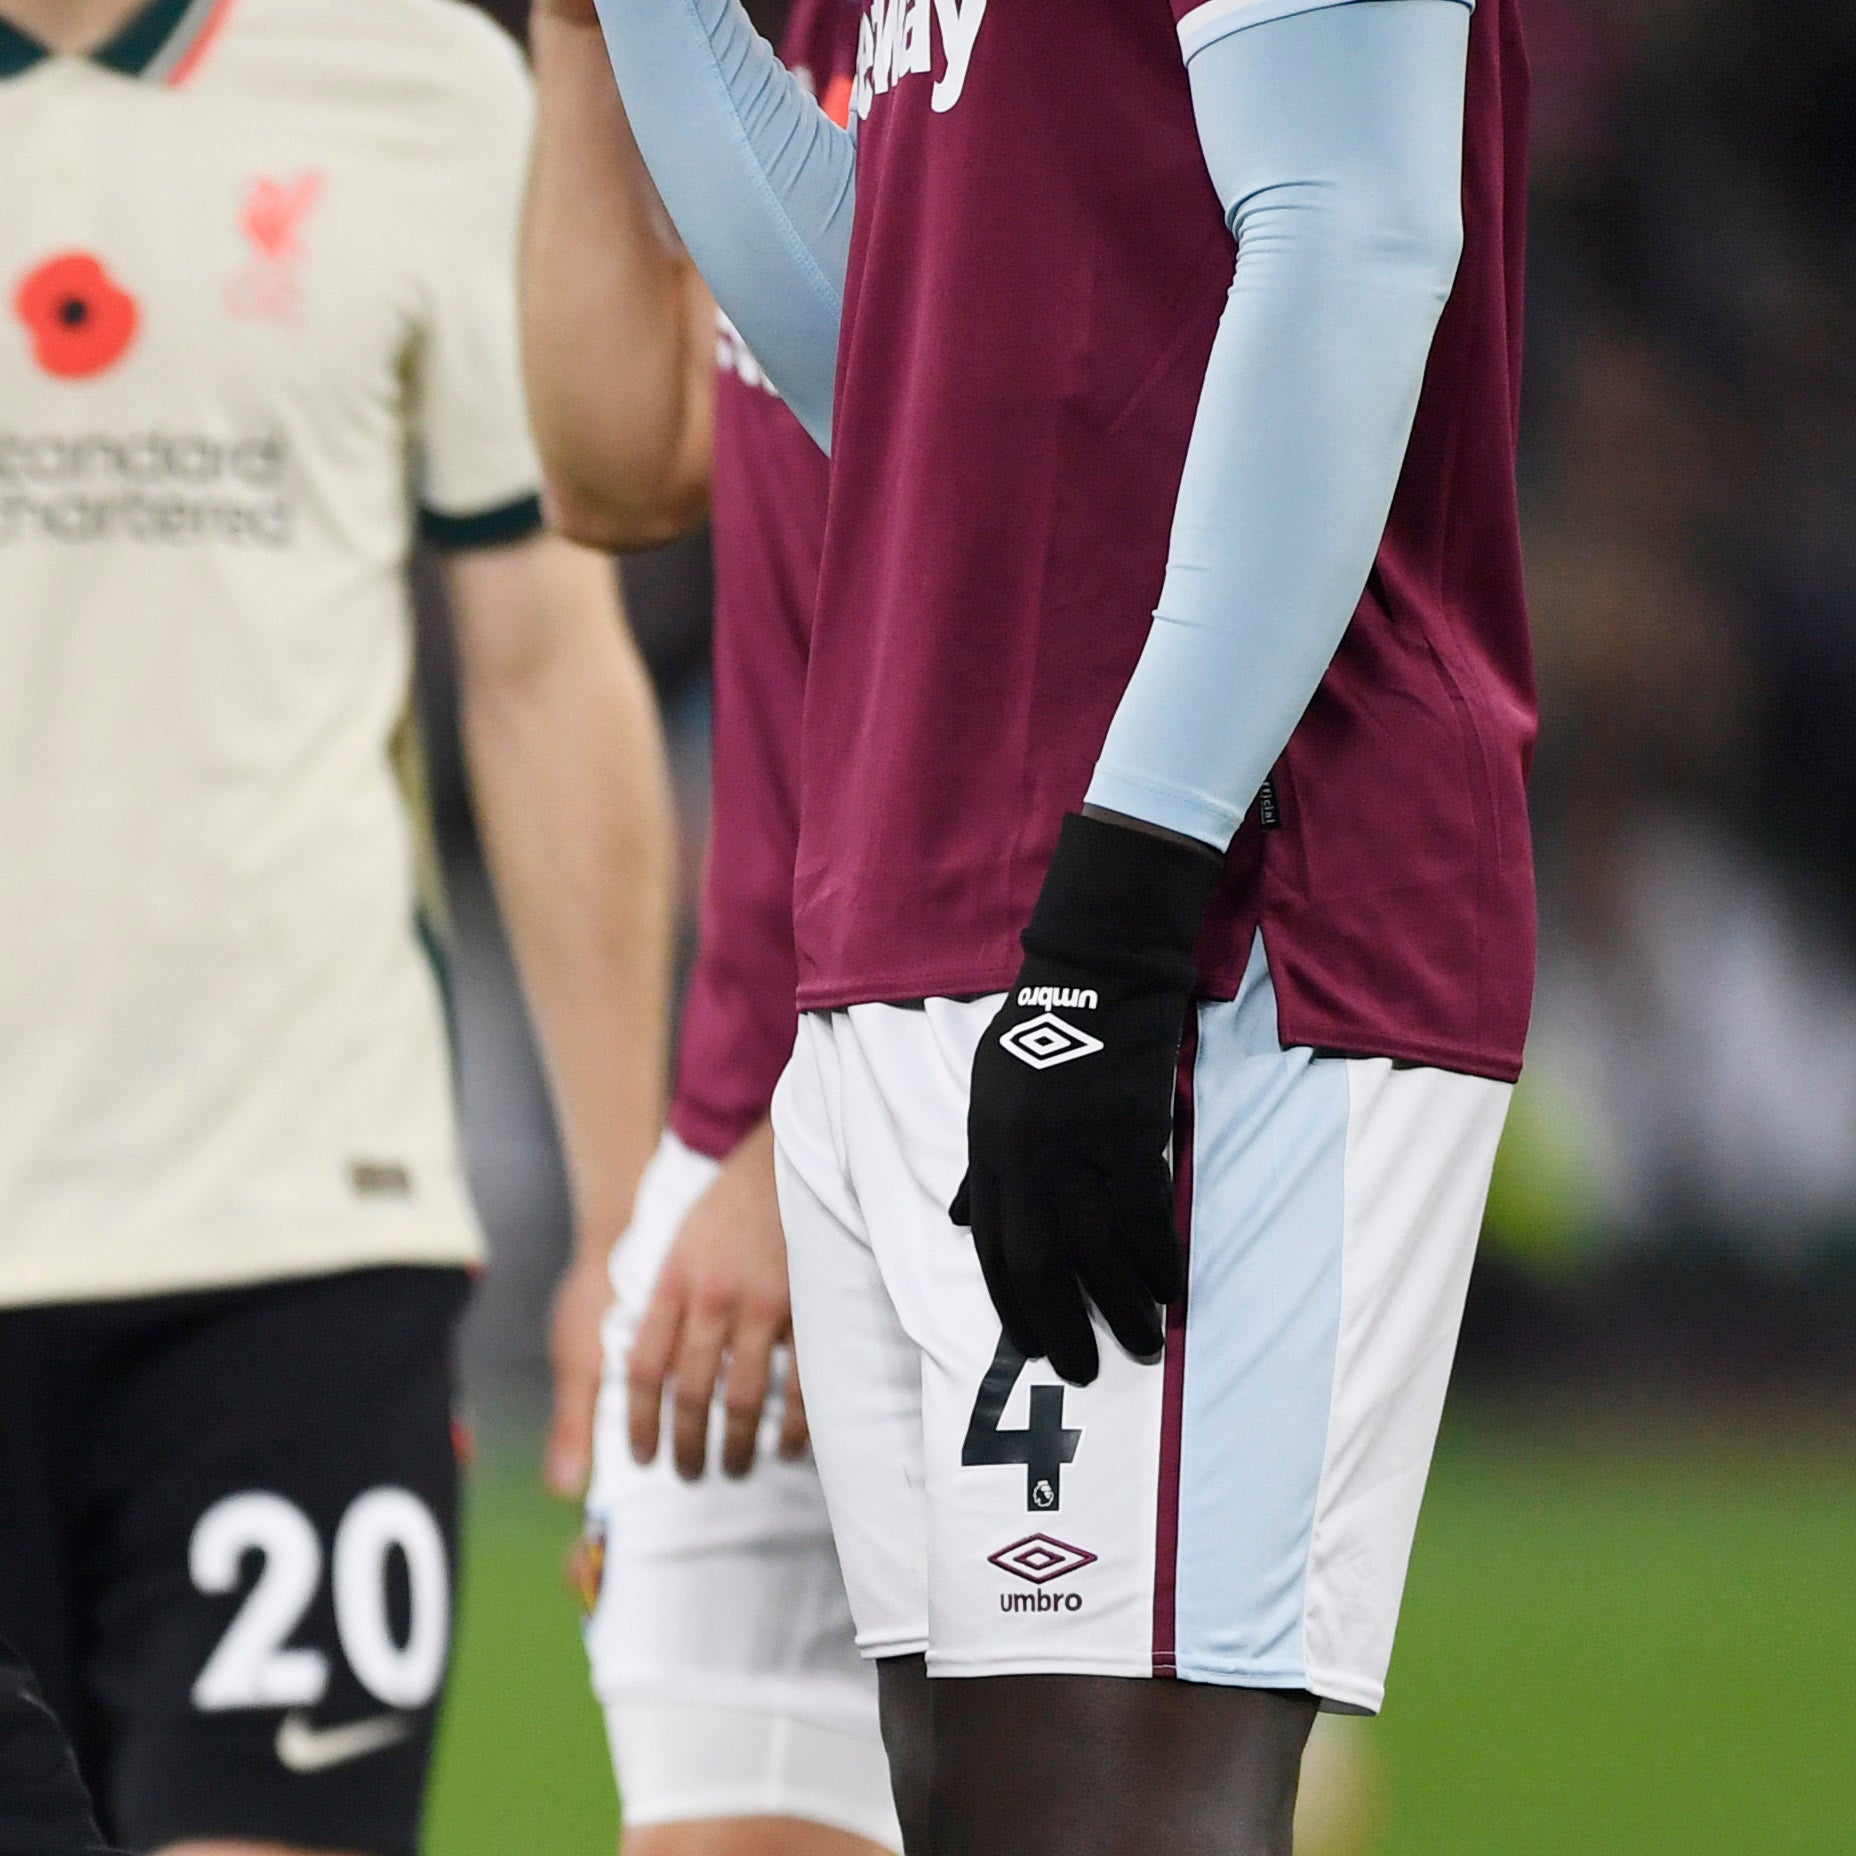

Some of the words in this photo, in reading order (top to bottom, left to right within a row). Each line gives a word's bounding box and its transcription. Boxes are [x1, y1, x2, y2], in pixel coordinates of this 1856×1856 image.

[856, 0, 989, 121] etway
[1017, 986, 1099, 1012] umbro
[961, 1332, 1083, 1512] 4
[188, 1484, 449, 1712] 20
[1000, 1588, 1083, 1613] umbro
